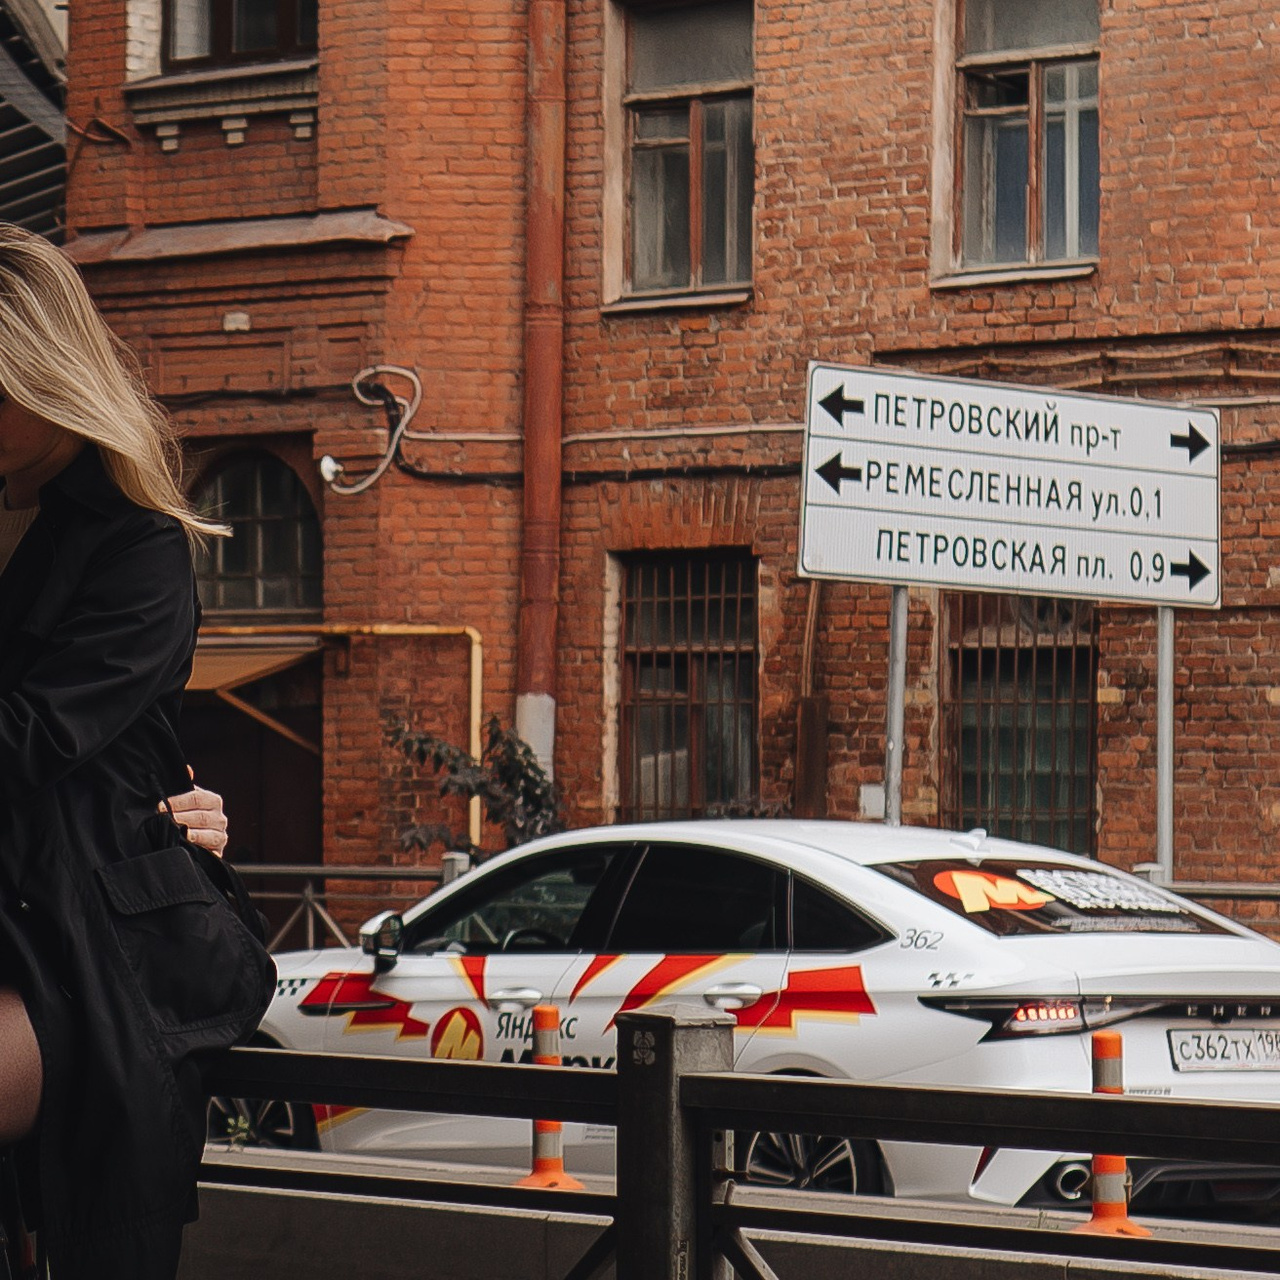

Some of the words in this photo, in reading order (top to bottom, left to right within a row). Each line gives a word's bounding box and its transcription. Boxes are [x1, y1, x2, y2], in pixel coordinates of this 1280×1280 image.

[874, 393, 1059, 444] ПЕТРОВСКИЙ
[1070, 424, 1120, 455] пр-т
[866, 460, 1082, 511] РЕМЕСЛЕННАЯ
[876, 529, 1066, 576] ПЕТРОВСКАЯ
[1077, 555, 1114, 580] пл.
[1130, 551, 1165, 588] 0,9
[900, 928, 944, 950] 362
